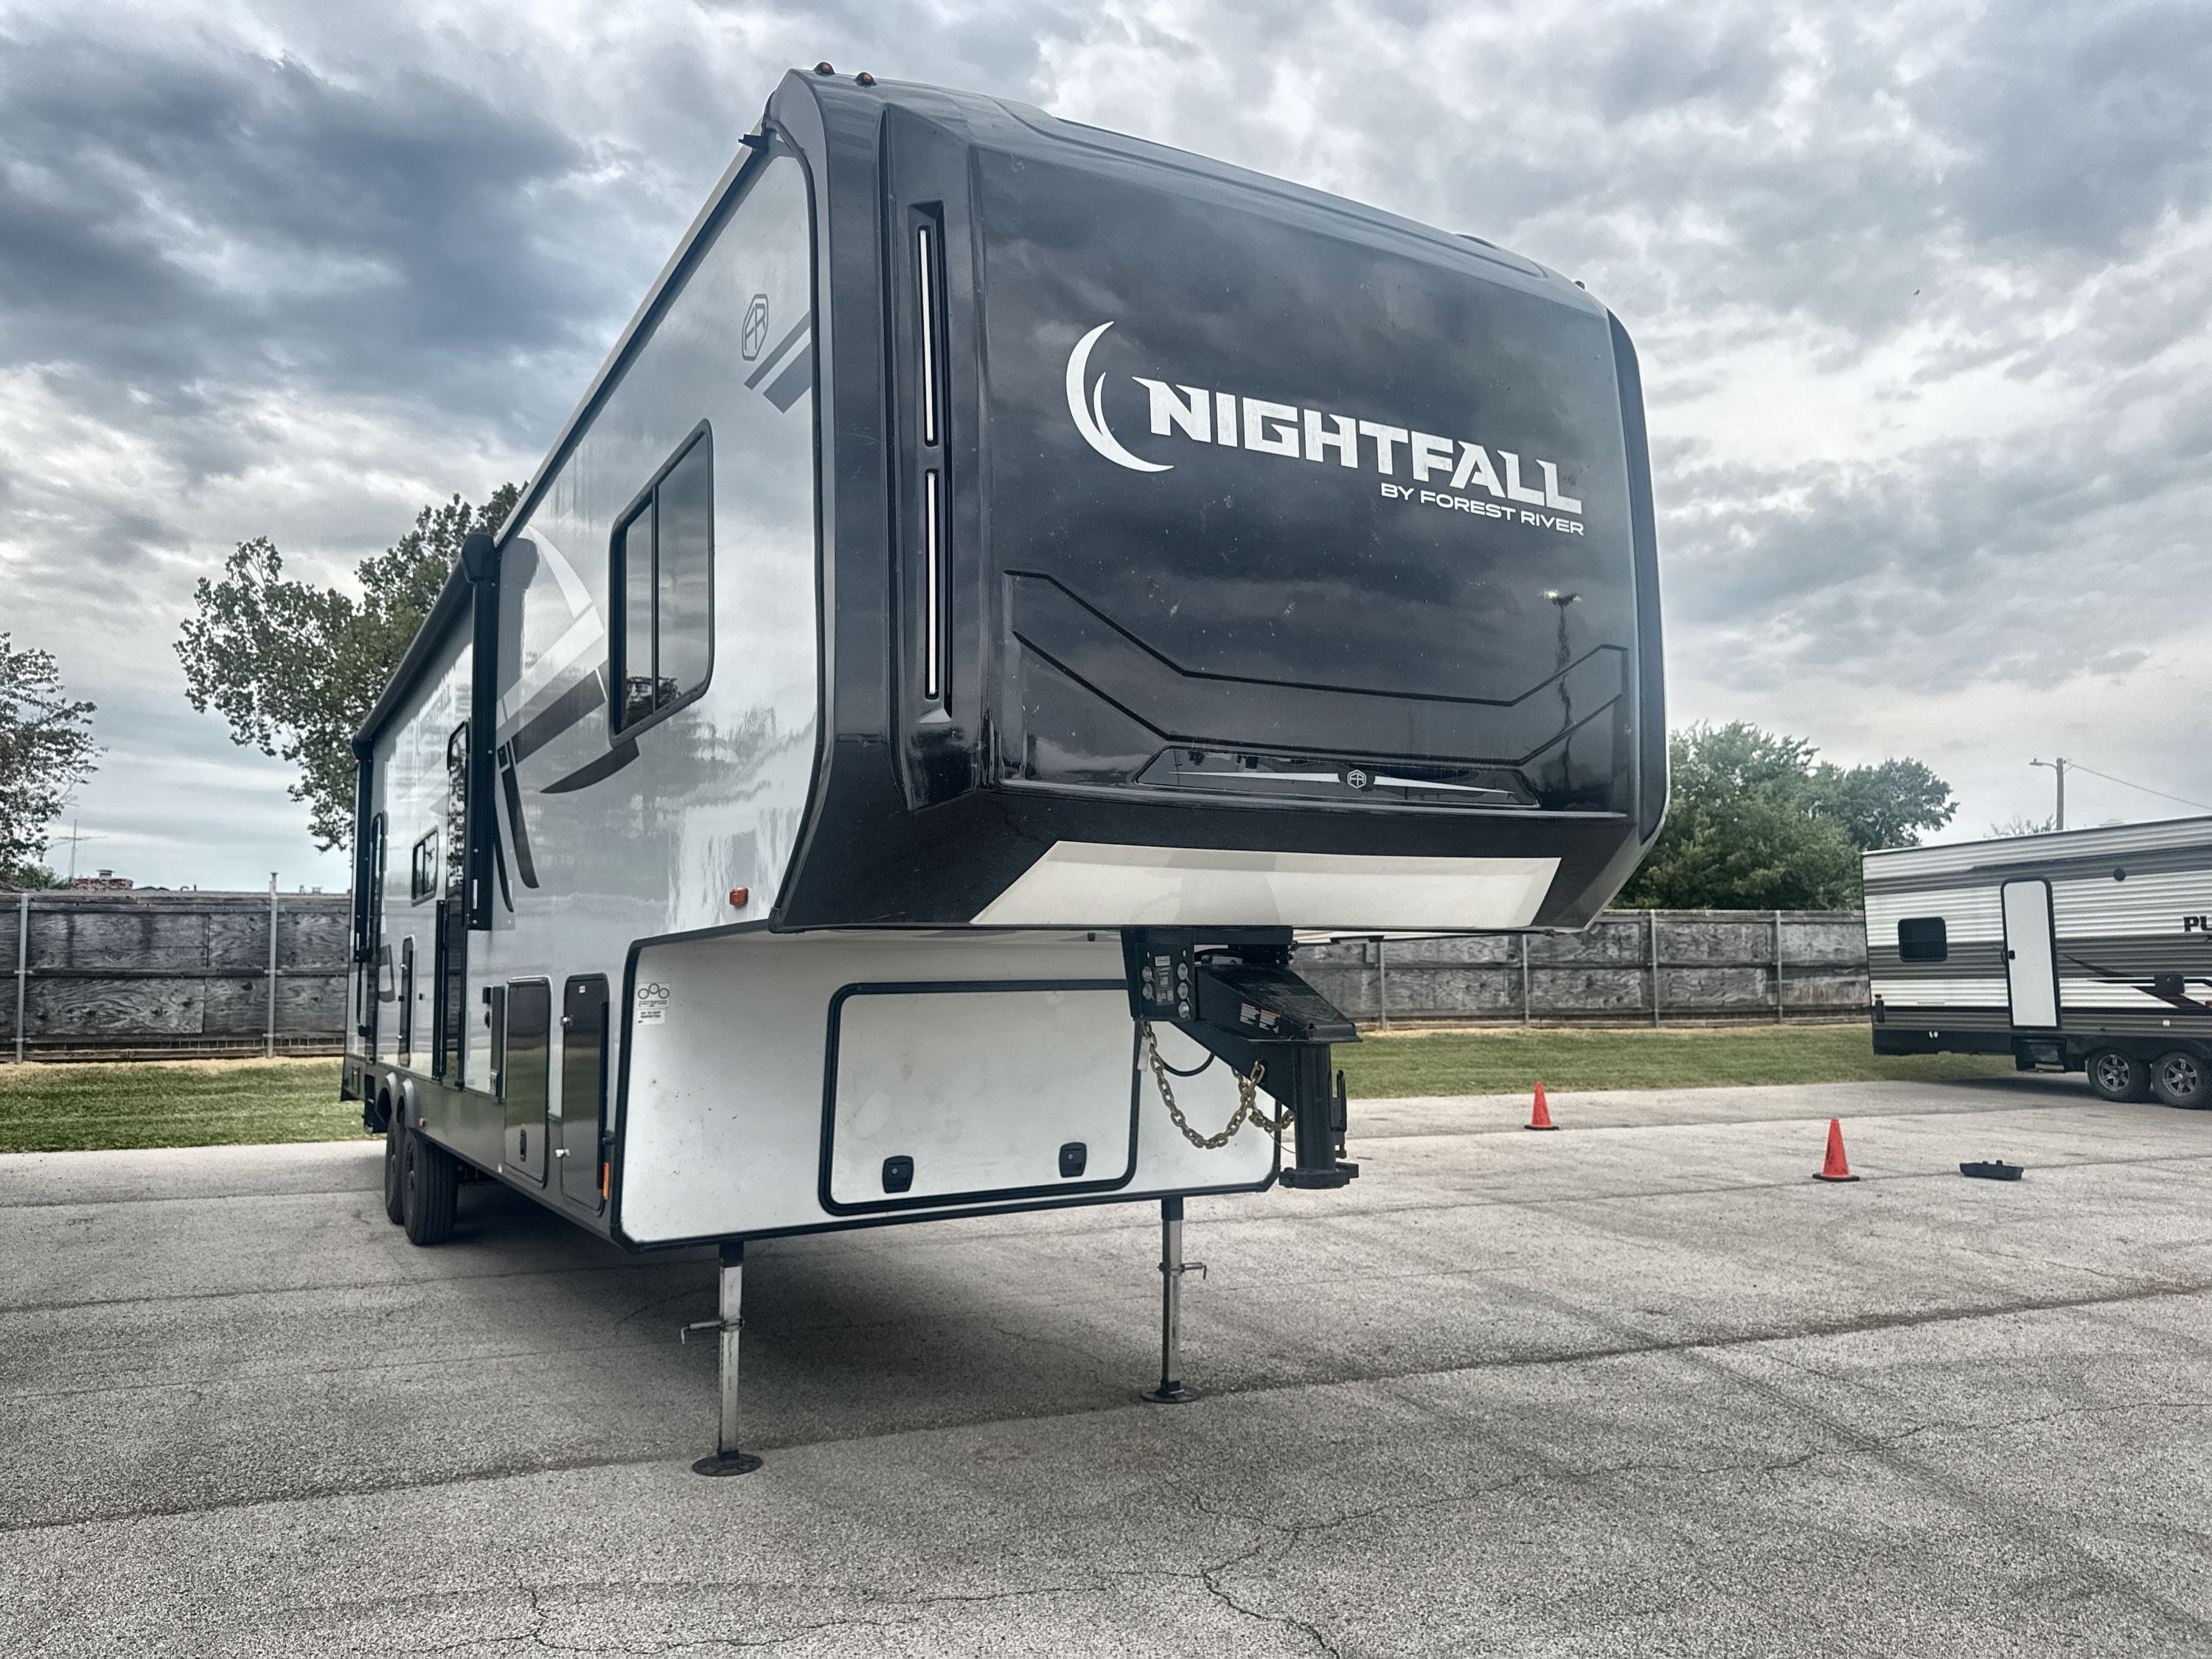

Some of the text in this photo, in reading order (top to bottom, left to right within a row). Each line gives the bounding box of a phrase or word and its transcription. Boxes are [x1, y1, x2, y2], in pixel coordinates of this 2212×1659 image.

[1132, 376, 1582, 515] NIGHTFALL
[1380, 482, 1585, 536] BY FOREST RIVER
